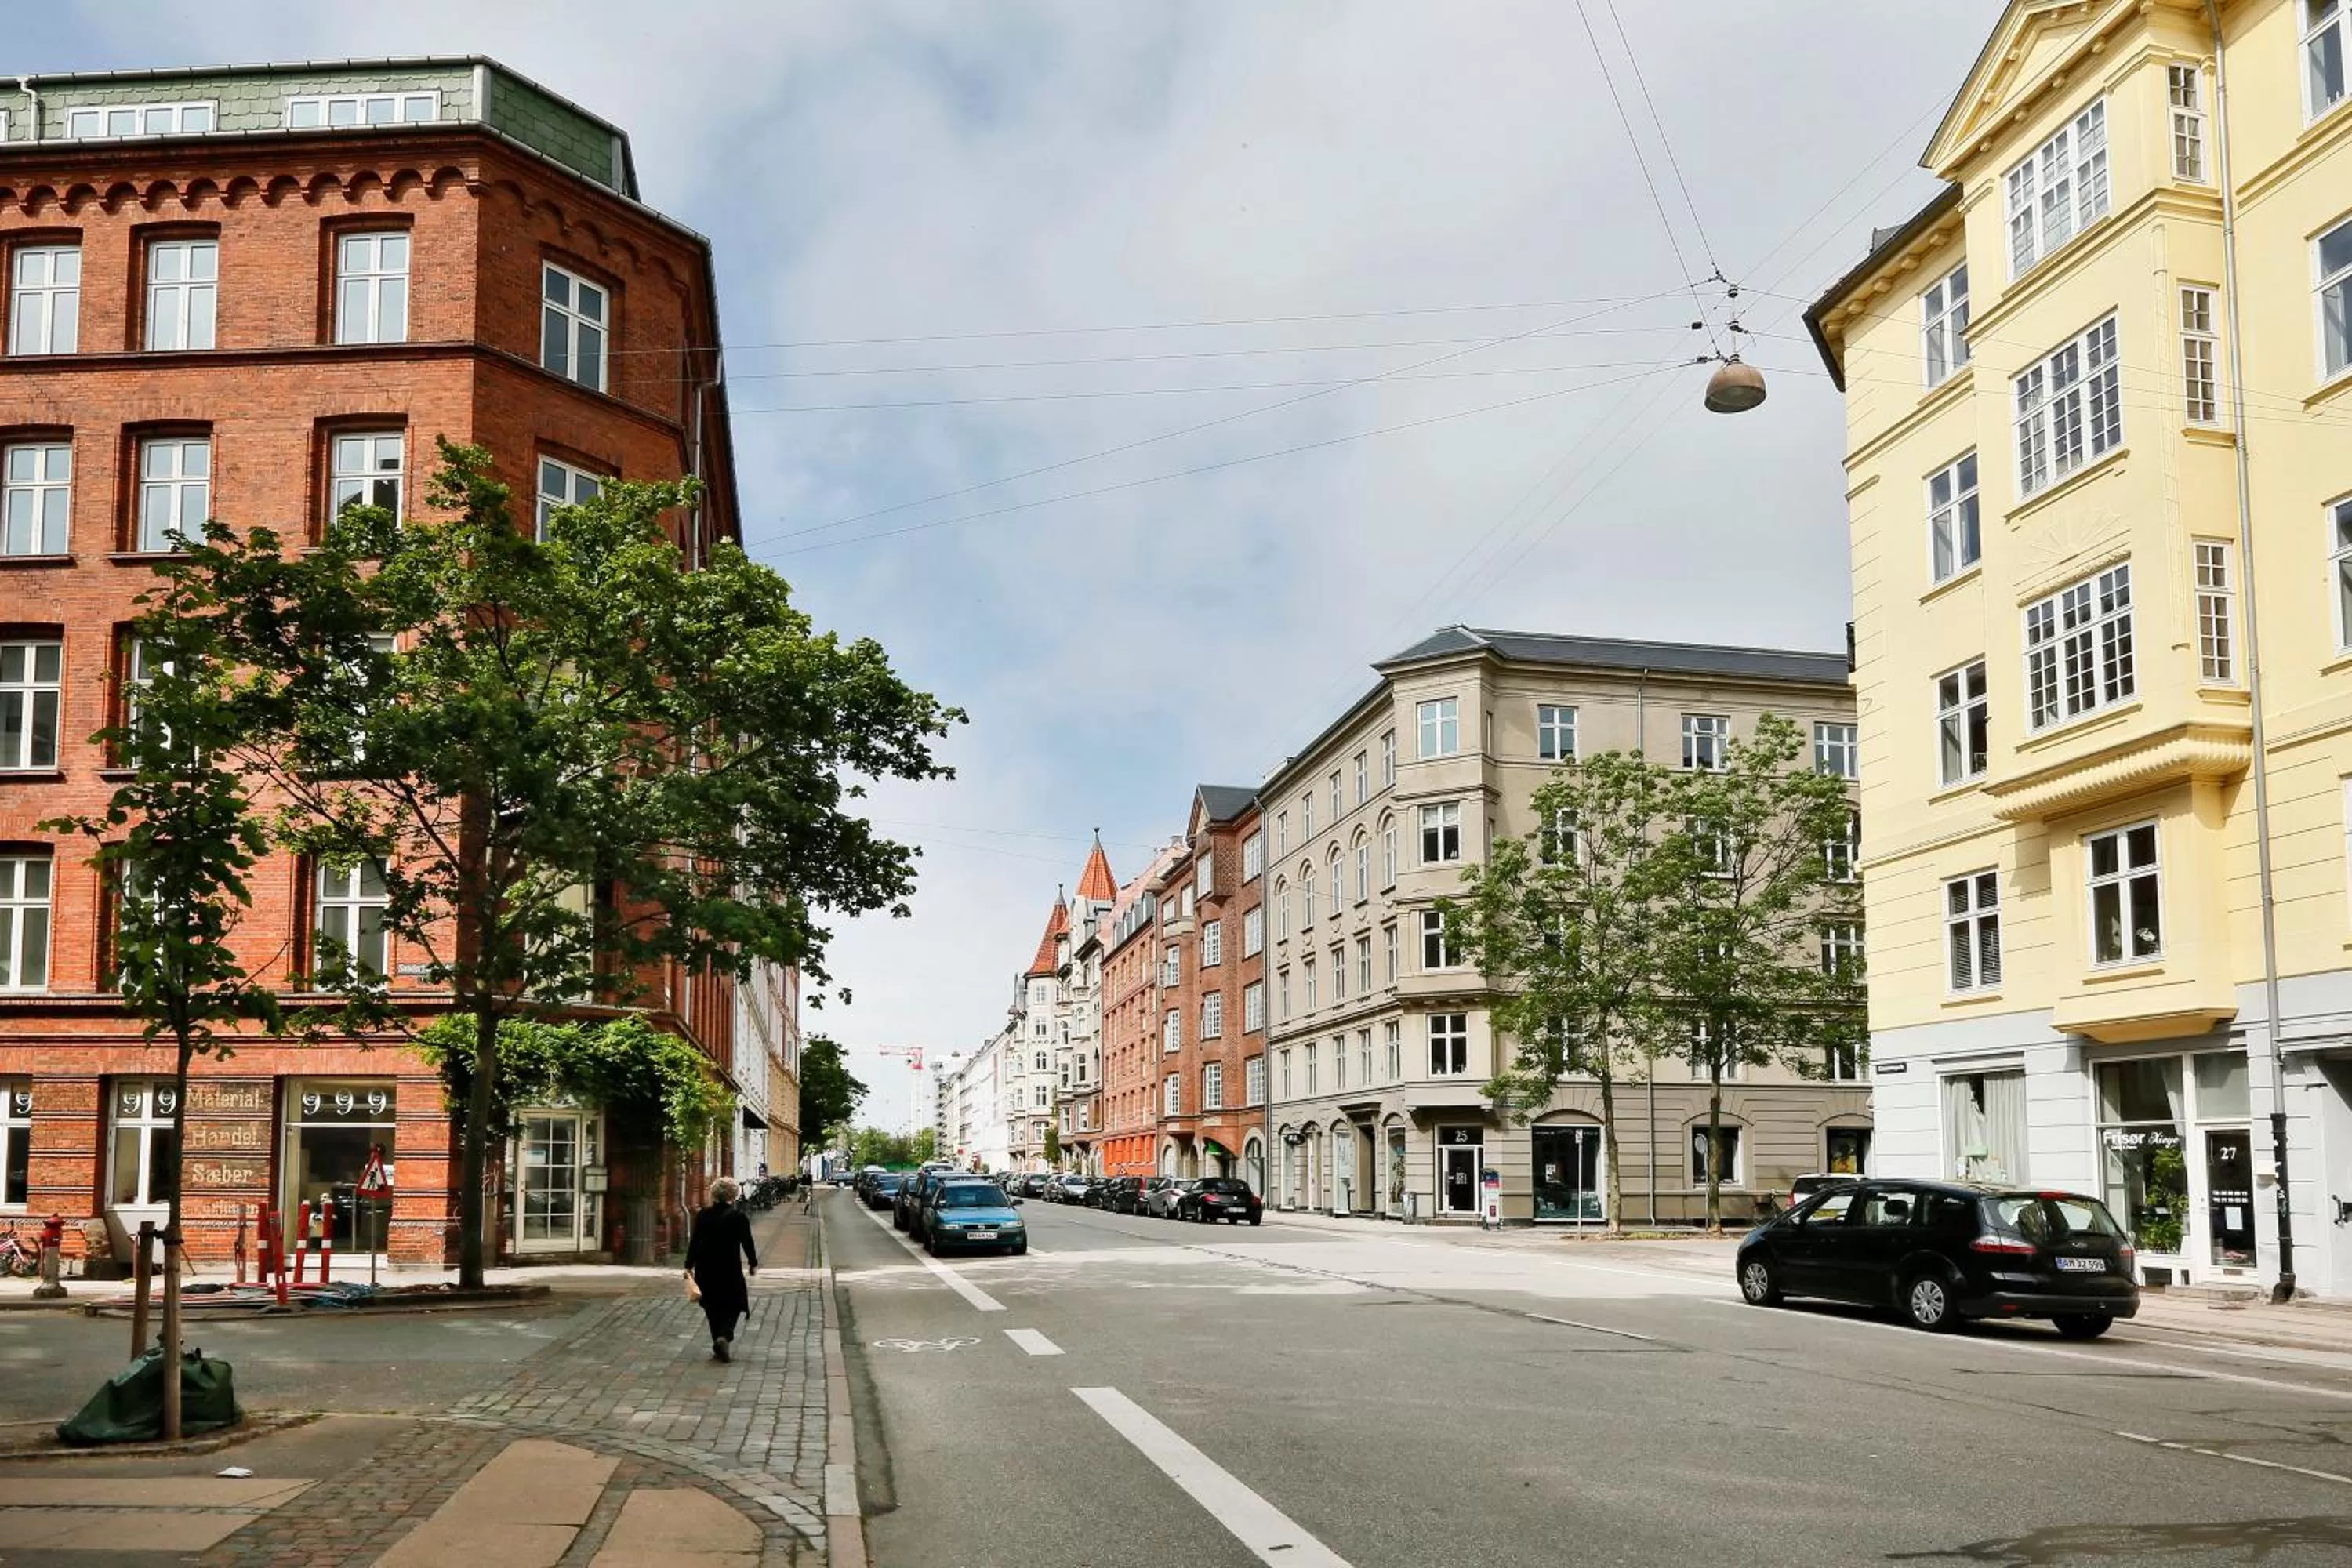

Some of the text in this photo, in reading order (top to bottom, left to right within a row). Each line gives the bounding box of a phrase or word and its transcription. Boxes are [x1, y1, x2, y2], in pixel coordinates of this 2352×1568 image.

[158, 1087, 176, 1114] 9
[1454, 1130, 1468, 1142] 25
[2103, 1131, 2146, 1145] Frisør
[2220, 1147, 2237, 1160] 27
[191, 1163, 253, 1183] Sæber
